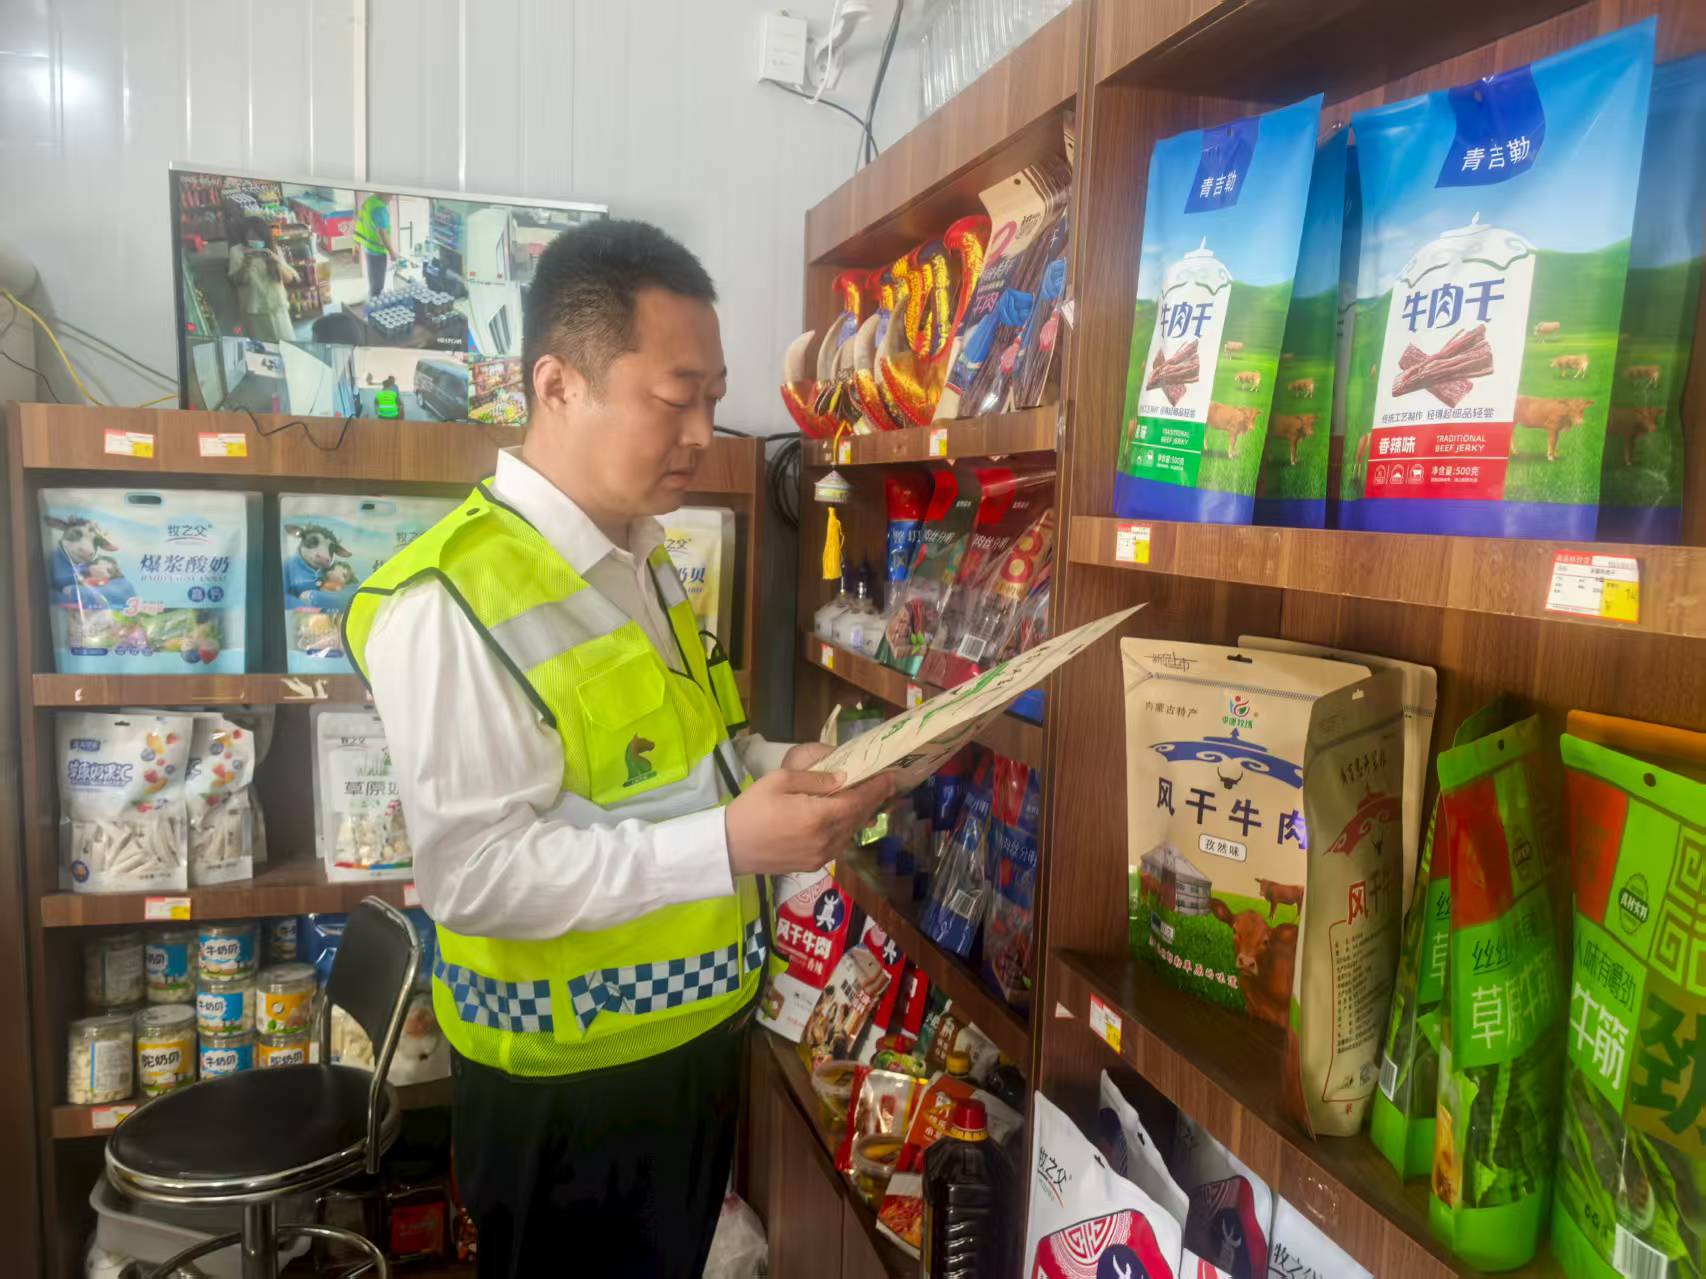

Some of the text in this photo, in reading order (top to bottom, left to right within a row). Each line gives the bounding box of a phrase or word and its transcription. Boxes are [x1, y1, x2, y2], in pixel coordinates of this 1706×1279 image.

[1460, 136, 1531, 173] 青吉勒
[1199, 170, 1237, 199] 青吉勒
[1402, 278, 1505, 333] 牛肉干
[1160, 300, 1213, 341] 牛肉干
[1379, 436, 1416, 455] 香辣味
[1435, 443, 1485, 453] BEEF JERKY
[1437, 434, 1486, 443] TRADITIONAL
[1431, 465, 1480, 477] 净含量:500克
[167, 524, 207, 537] 牧之父
[396, 532, 423, 542] 牧之
[141, 554, 229, 573] 爆浆酸奶
[1145, 701, 1197, 717] 内蒙古特产
[1157, 777, 1308, 850] 风干牛肉
[1204, 839, 1240, 857] 孜然味
[777, 918, 832, 960] 风干牛肉
[1570, 981, 1628, 1091] 牛筋
